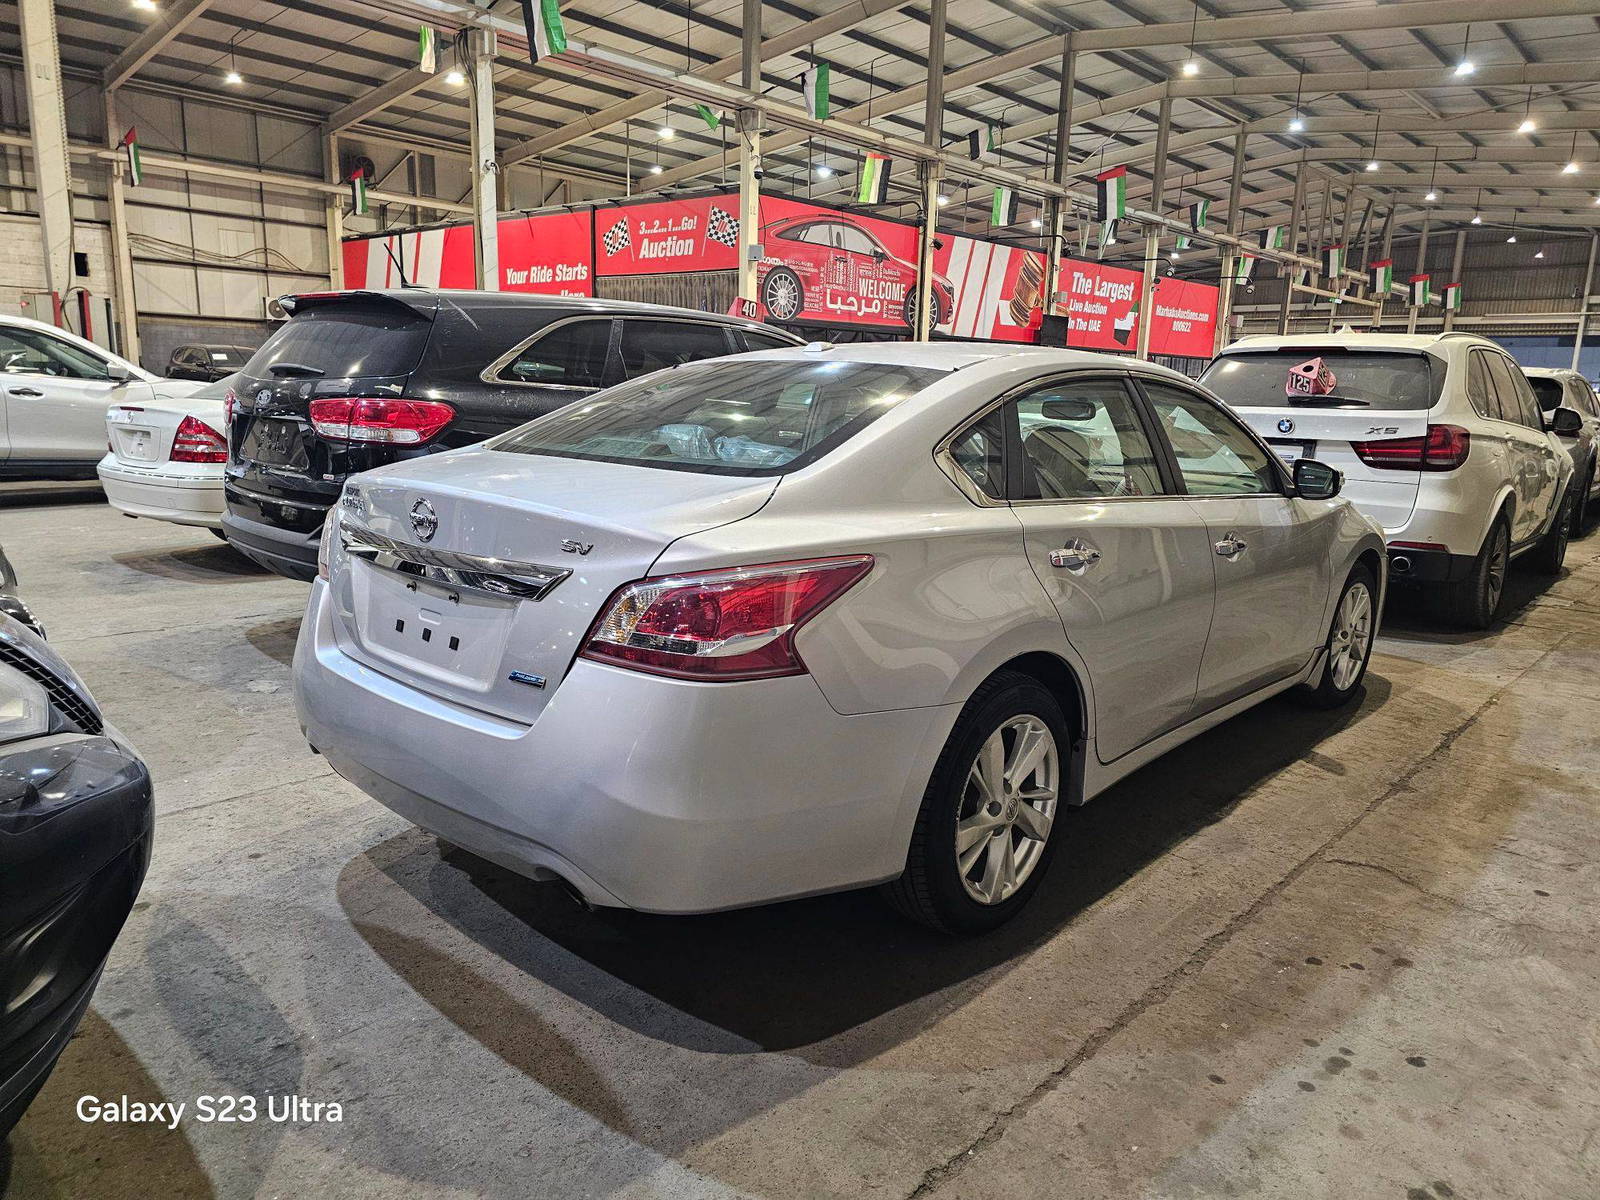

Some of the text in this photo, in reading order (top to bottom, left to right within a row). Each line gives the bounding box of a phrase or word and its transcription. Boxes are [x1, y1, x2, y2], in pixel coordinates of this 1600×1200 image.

[639, 236, 694, 259] Auction
[506, 262, 588, 285] Your Ride Starts
[858, 277, 906, 302] WELCOME
[1071, 271, 1135, 303] The Largest
[742, 300, 757, 318] 40
[826, 288, 881, 316] مرحبا
[1069, 299, 1108, 315] Live Auction
[1067, 316, 1102, 333] In The UAE
[1291, 373, 1310, 393] 125
[1364, 427, 1399, 435] X5
[560, 539, 594, 556] SV
